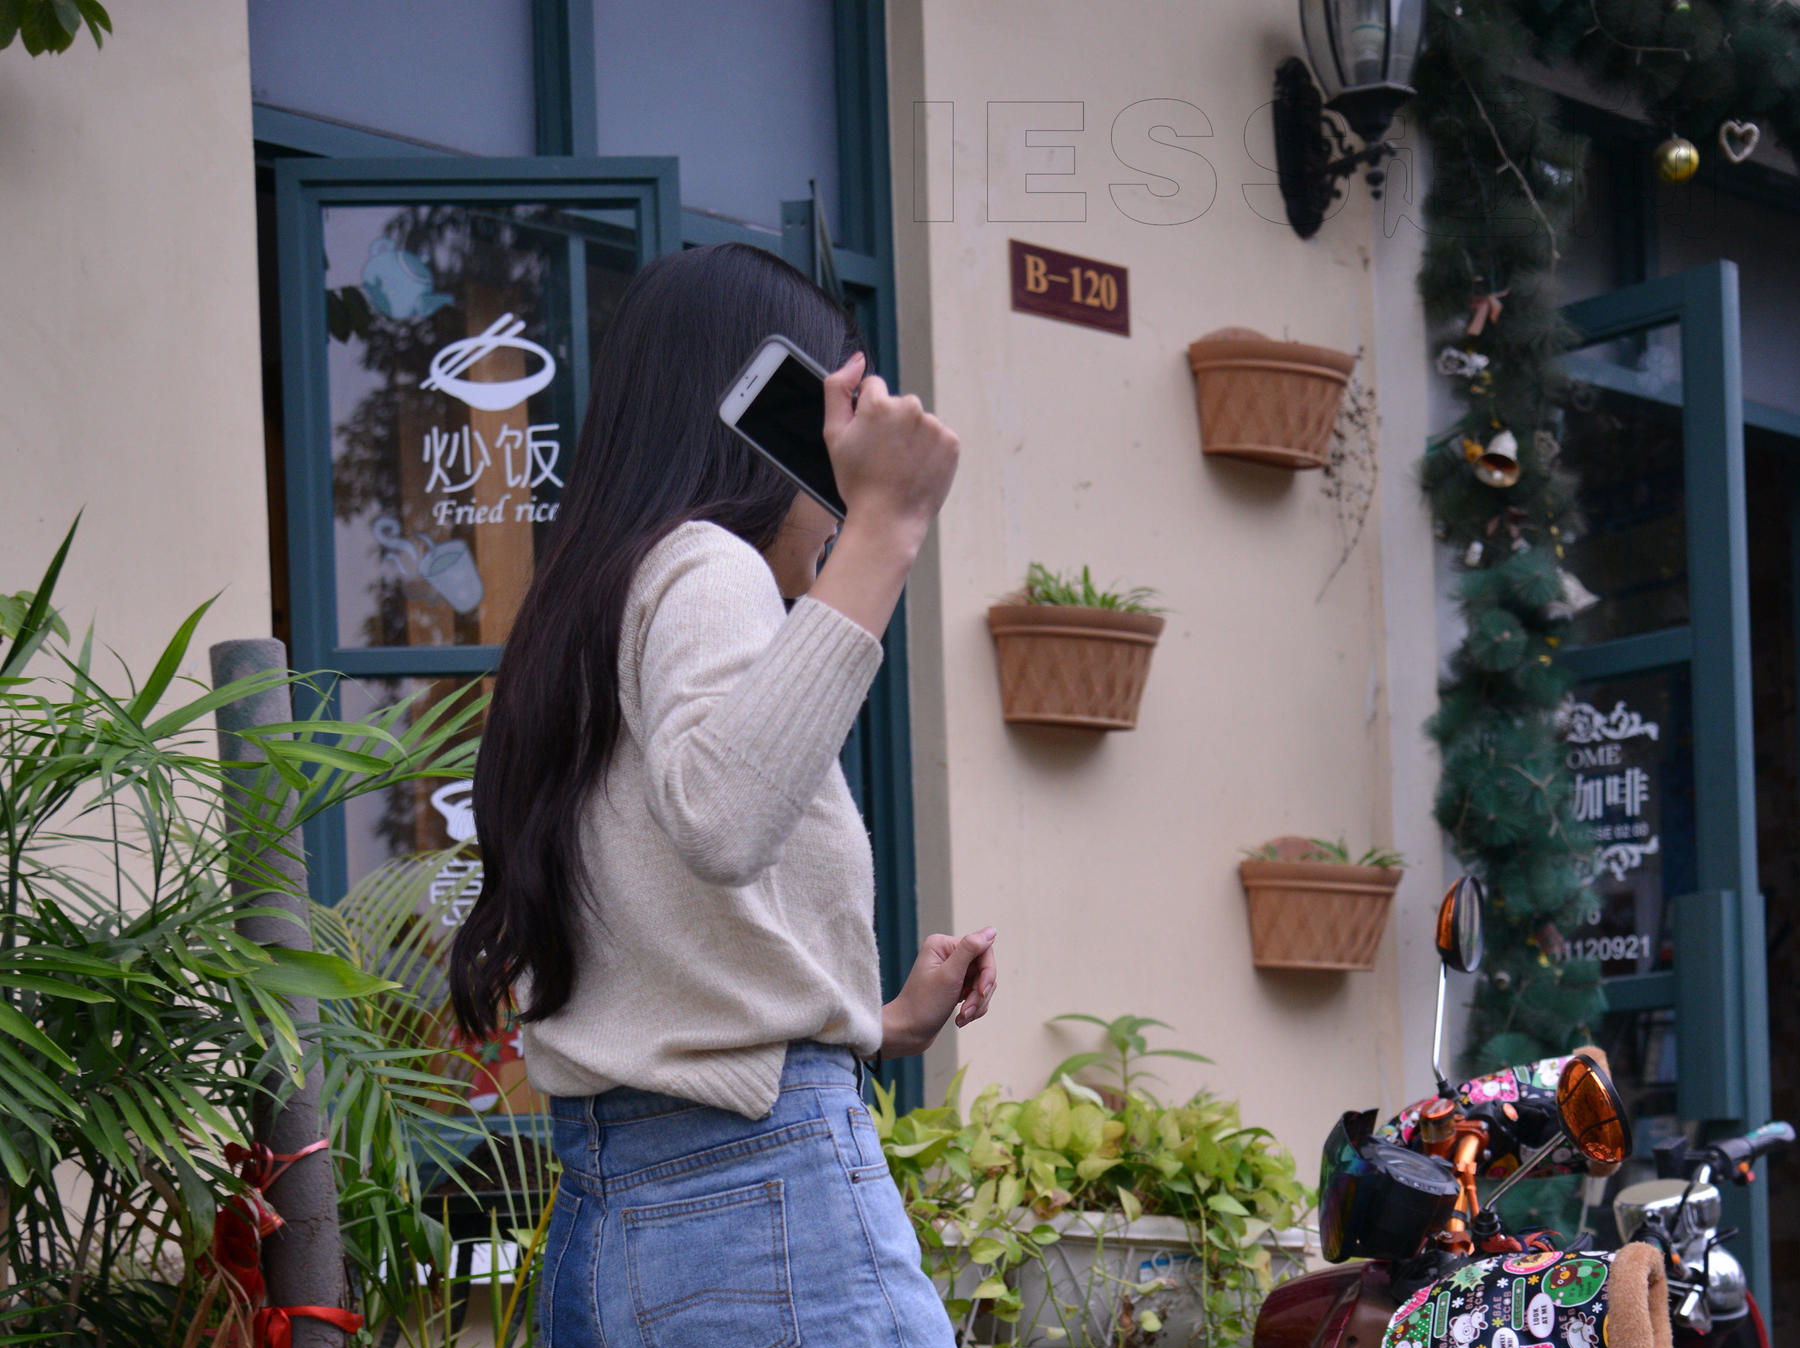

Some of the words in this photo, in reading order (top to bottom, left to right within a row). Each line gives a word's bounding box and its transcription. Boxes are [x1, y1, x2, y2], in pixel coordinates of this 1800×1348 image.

[1024, 254, 1118, 312] B-120
[422, 423, 564, 493] 炒饭
[432, 494, 512, 526] Fried
[1566, 744, 1622, 770] OME
